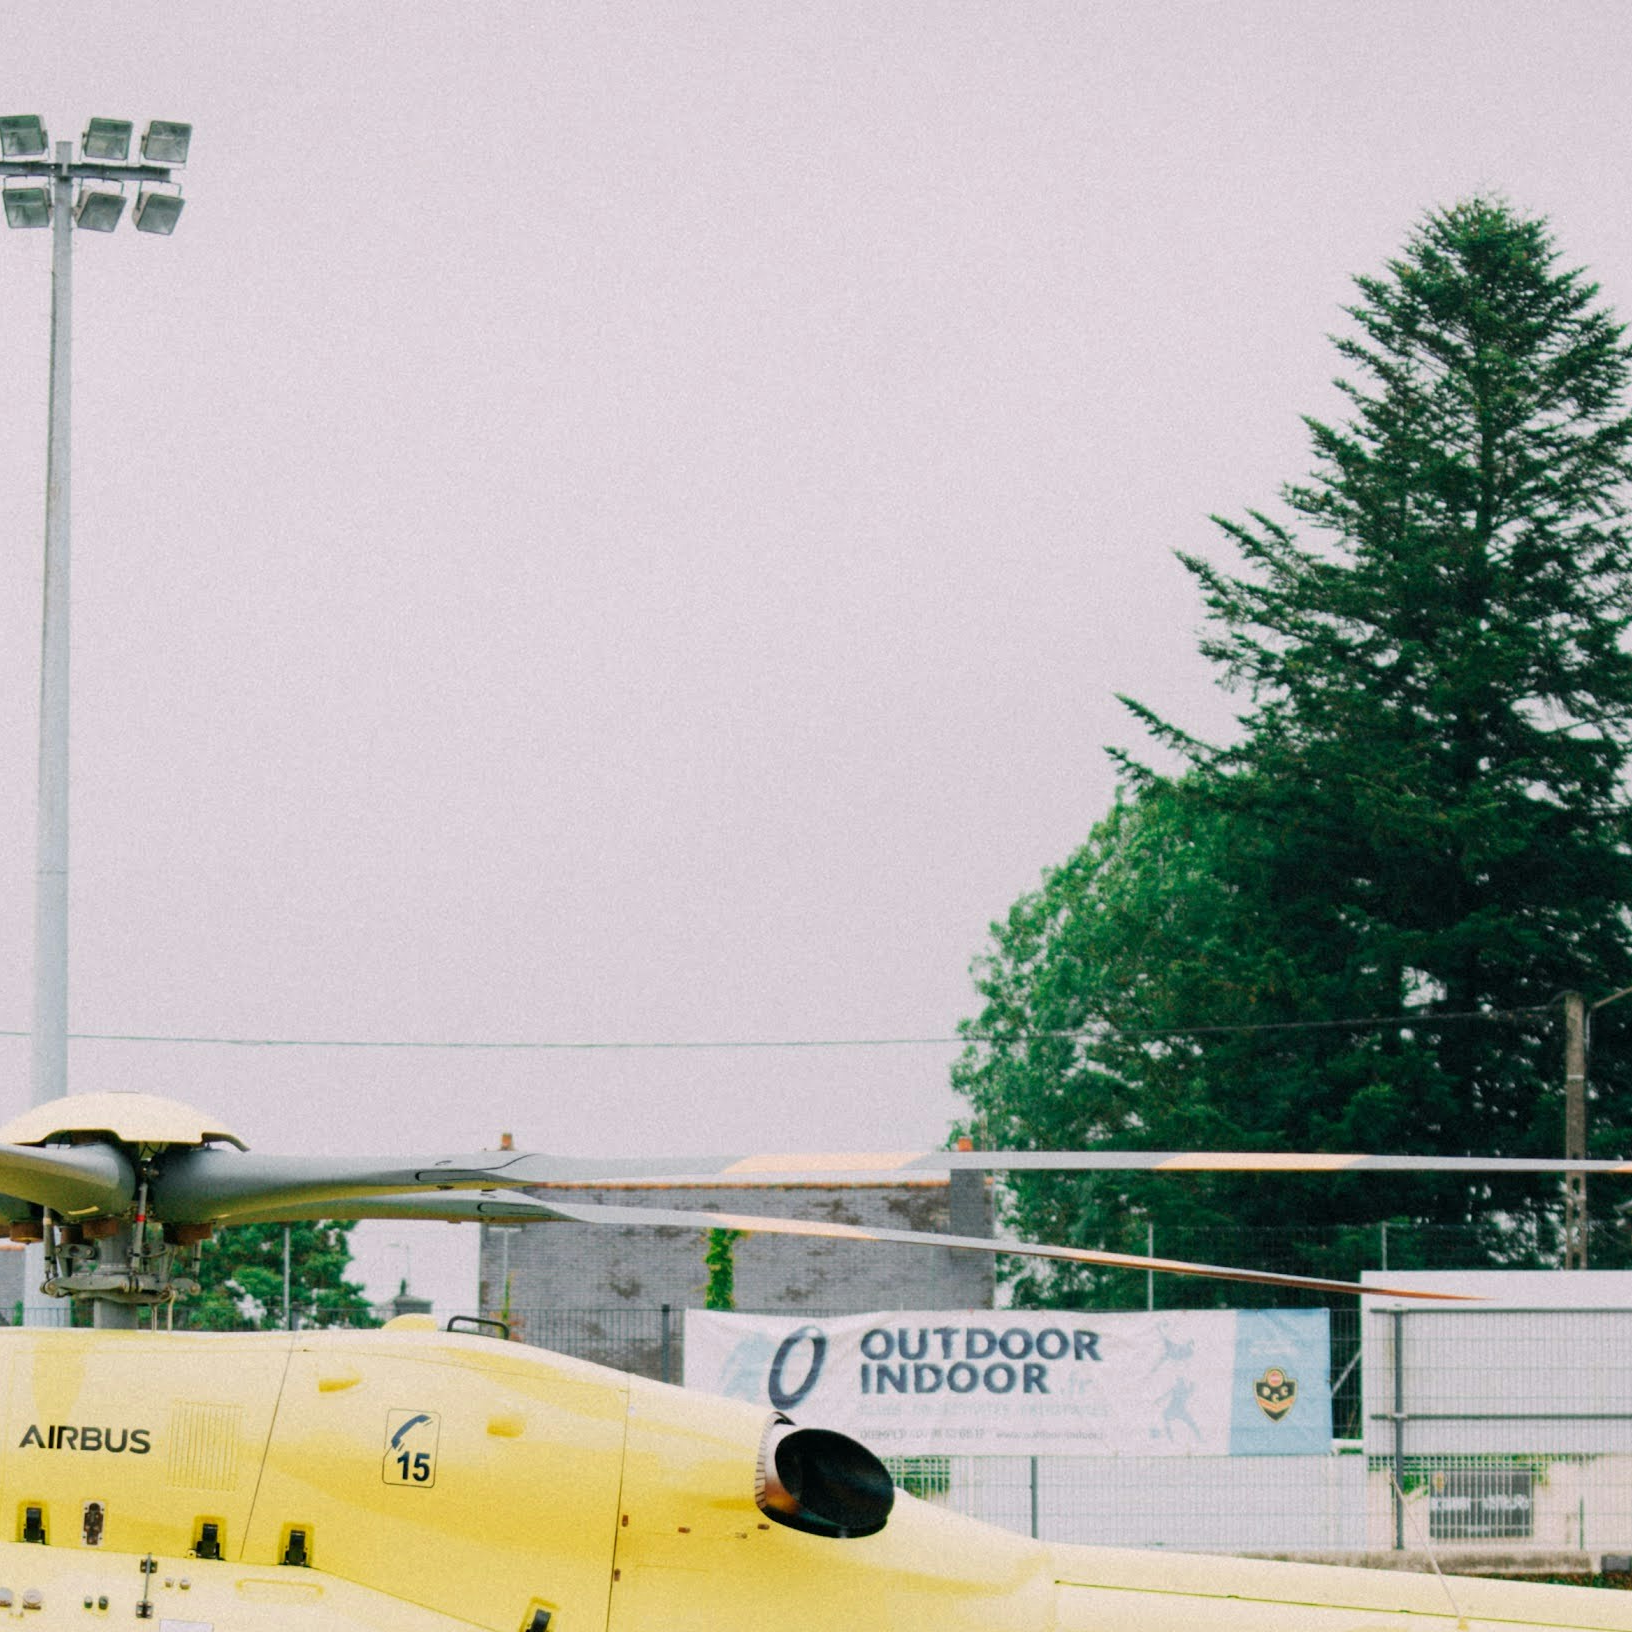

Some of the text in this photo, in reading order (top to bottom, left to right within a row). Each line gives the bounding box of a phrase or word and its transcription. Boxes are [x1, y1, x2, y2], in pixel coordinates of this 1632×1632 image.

[860, 1327, 1102, 1361] OUTDOOR
[860, 1362, 1051, 1394] INDOOR
[18, 1424, 151, 1455] AIRBUS
[396, 1450, 431, 1482] 15
